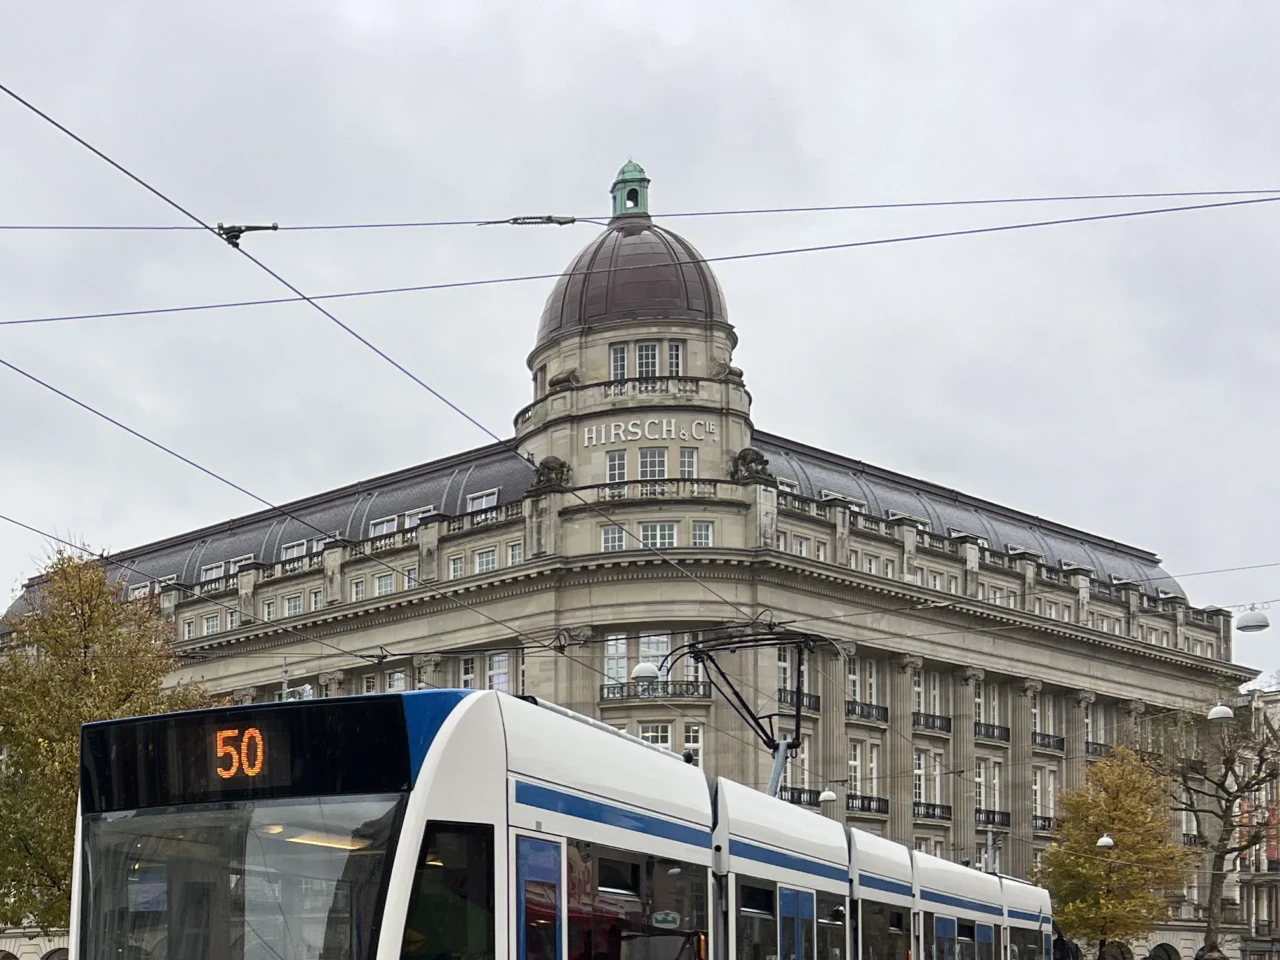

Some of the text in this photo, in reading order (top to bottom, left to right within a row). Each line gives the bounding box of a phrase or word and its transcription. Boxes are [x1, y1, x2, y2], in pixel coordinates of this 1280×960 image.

[583, 418, 676, 448] HIRSCH
[679, 425, 690, 441] &
[216, 727, 264, 778] 50
